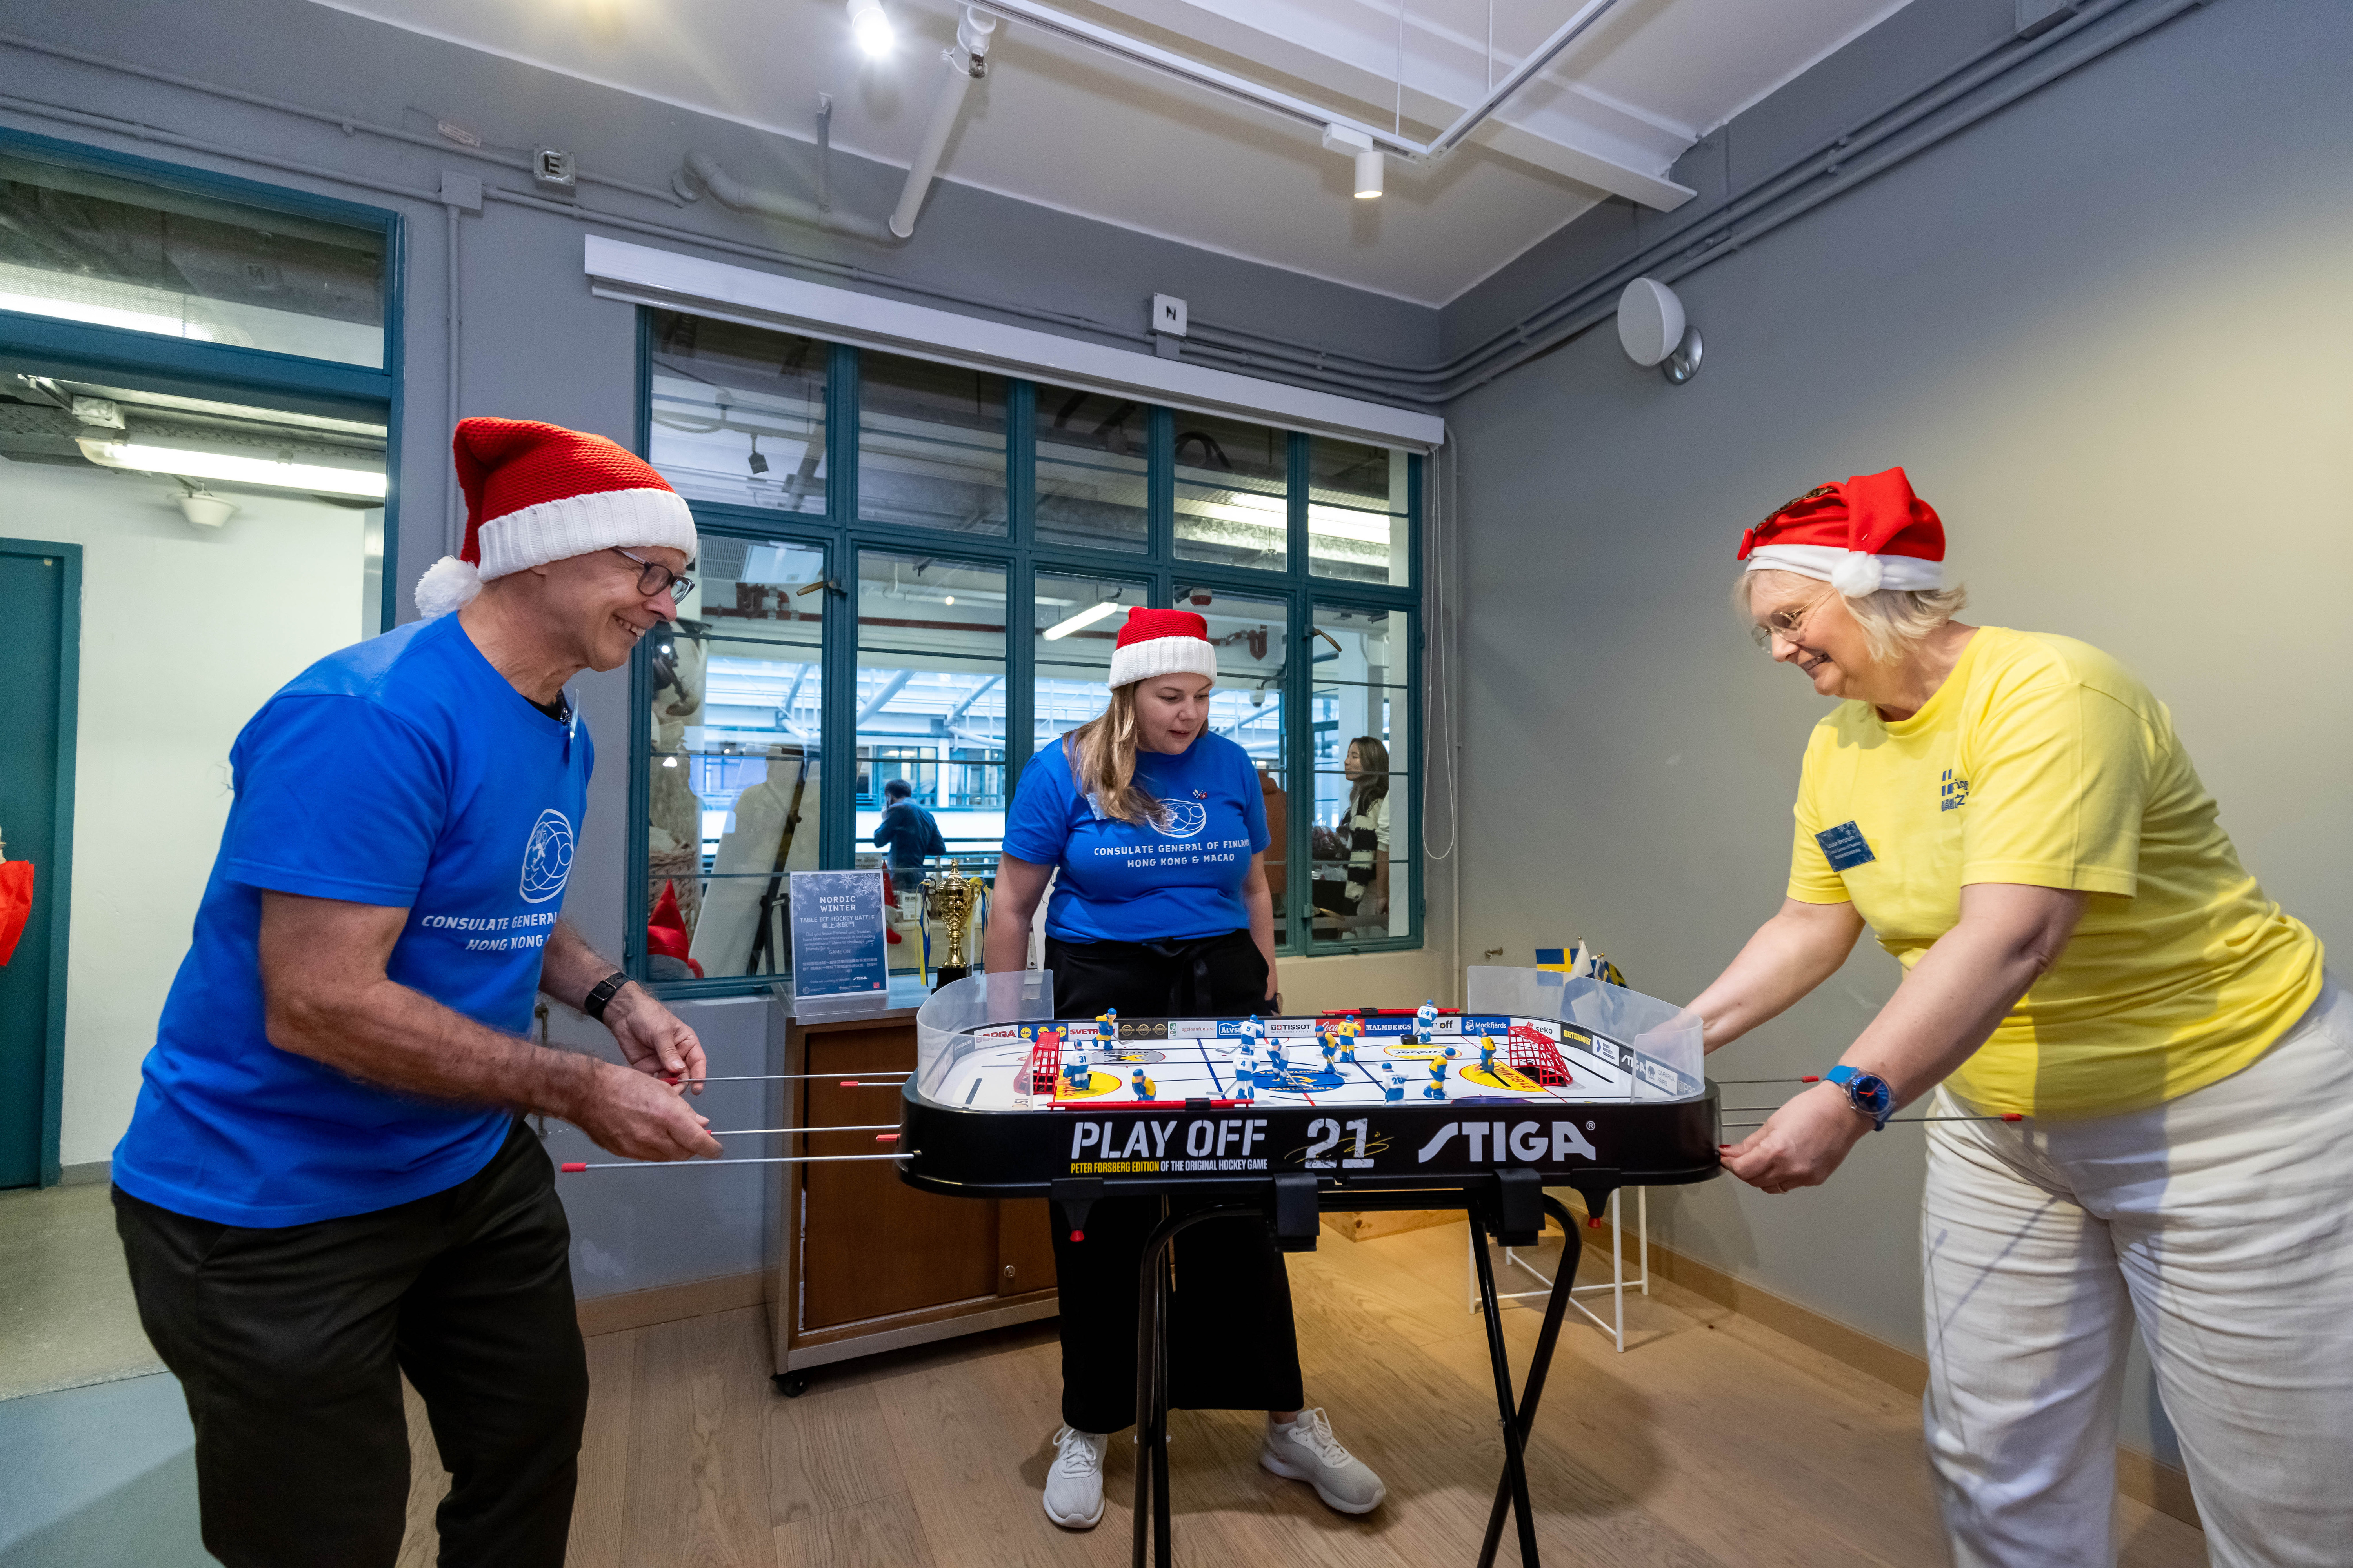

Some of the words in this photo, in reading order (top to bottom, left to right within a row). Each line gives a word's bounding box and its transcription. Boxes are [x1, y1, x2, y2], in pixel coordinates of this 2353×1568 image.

[544, 154, 560, 174] E
[1166, 305, 1176, 321] N
[1094, 846, 1153, 856] CONSULATE
[1158, 843, 1203, 852] GENERAL
[1207, 841, 1219, 850] OF
[1224, 839, 1250, 848] FINLAND
[1127, 858, 1156, 868] HONG
[1161, 857, 1187, 865] KONG
[1204, 854, 1235, 863] MACAO
[421, 916, 509, 930] CONSULATE
[465, 939, 507, 950] HONG
[511, 935, 543, 950] KONG
[1440, 1020, 1453, 1029] off
[1071, 1121, 1177, 1159] PLAY
[1187, 1119, 1267, 1157] OFF
[1304, 1118, 1374, 1168] 21
[1071, 1163, 1093, 1174] PETER
[1094, 1162, 1130, 1173] FORSBERG
[1132, 1161, 1159, 1172] EDITION
[1160, 1161, 1170, 1172] OF
[1171, 1160, 1184, 1171] THE
[1186, 1159, 1217, 1171] ORIGINAL
[1218, 1159, 1246, 1170] HOCKEY
[1247, 1159, 1268, 1170] GAME
